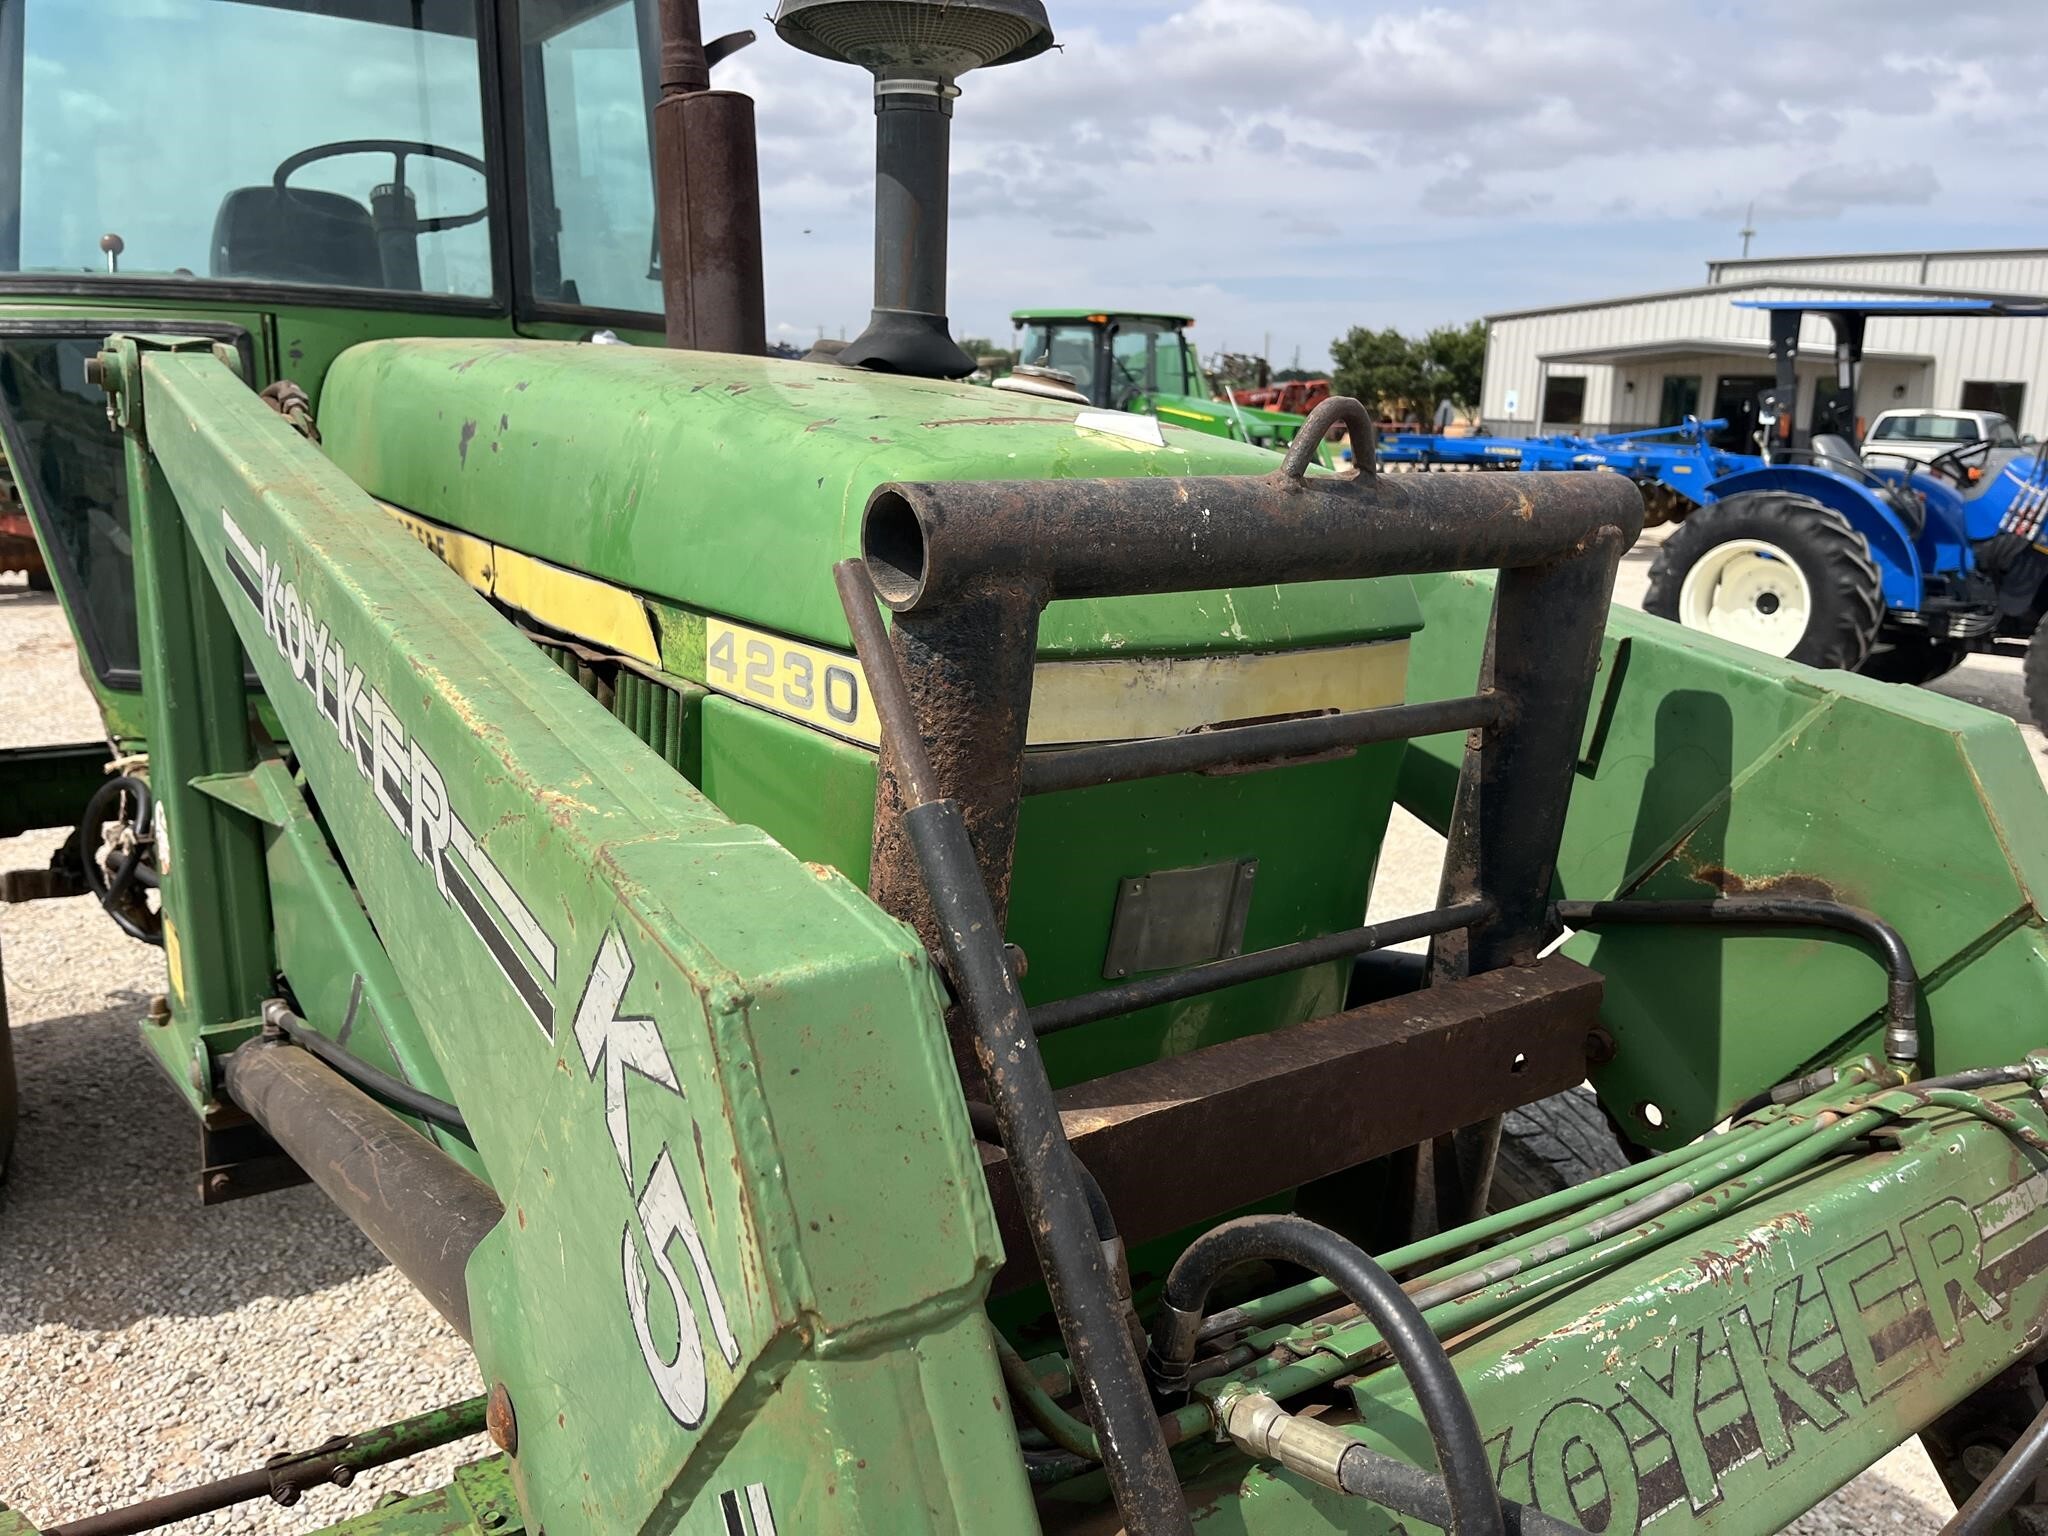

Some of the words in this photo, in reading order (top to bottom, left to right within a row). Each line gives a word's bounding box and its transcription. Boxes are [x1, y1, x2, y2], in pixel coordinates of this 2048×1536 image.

[260, 542, 453, 909] KOYKER
[709, 630, 859, 726] 4230
[572, 914, 742, 1432] K5
[1483, 1197, 2003, 1536] OYKER
